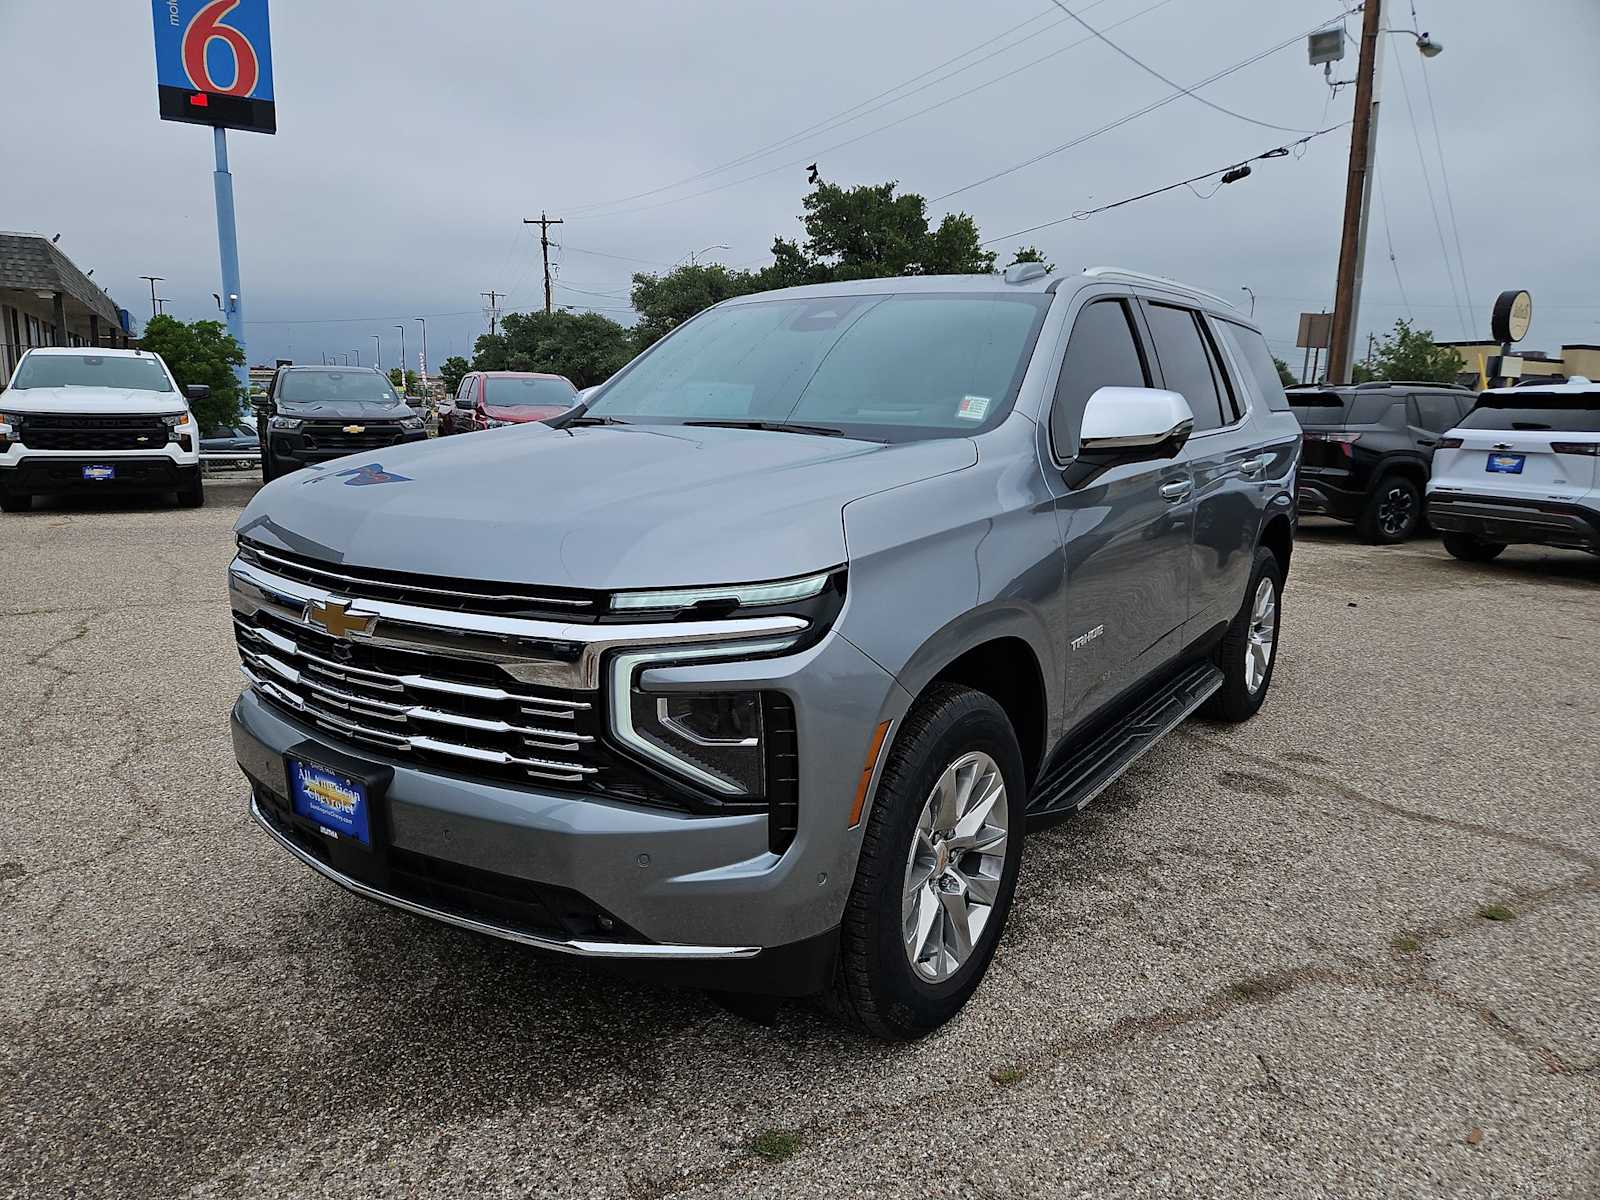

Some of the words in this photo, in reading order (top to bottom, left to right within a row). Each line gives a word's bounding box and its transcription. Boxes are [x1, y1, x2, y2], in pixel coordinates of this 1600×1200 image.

[181, 0, 259, 97] 6
[1071, 624, 1104, 651] TAHOE
[298, 768, 311, 784] All
[314, 775, 361, 802] American
[307, 788, 355, 815] Chevrolet
